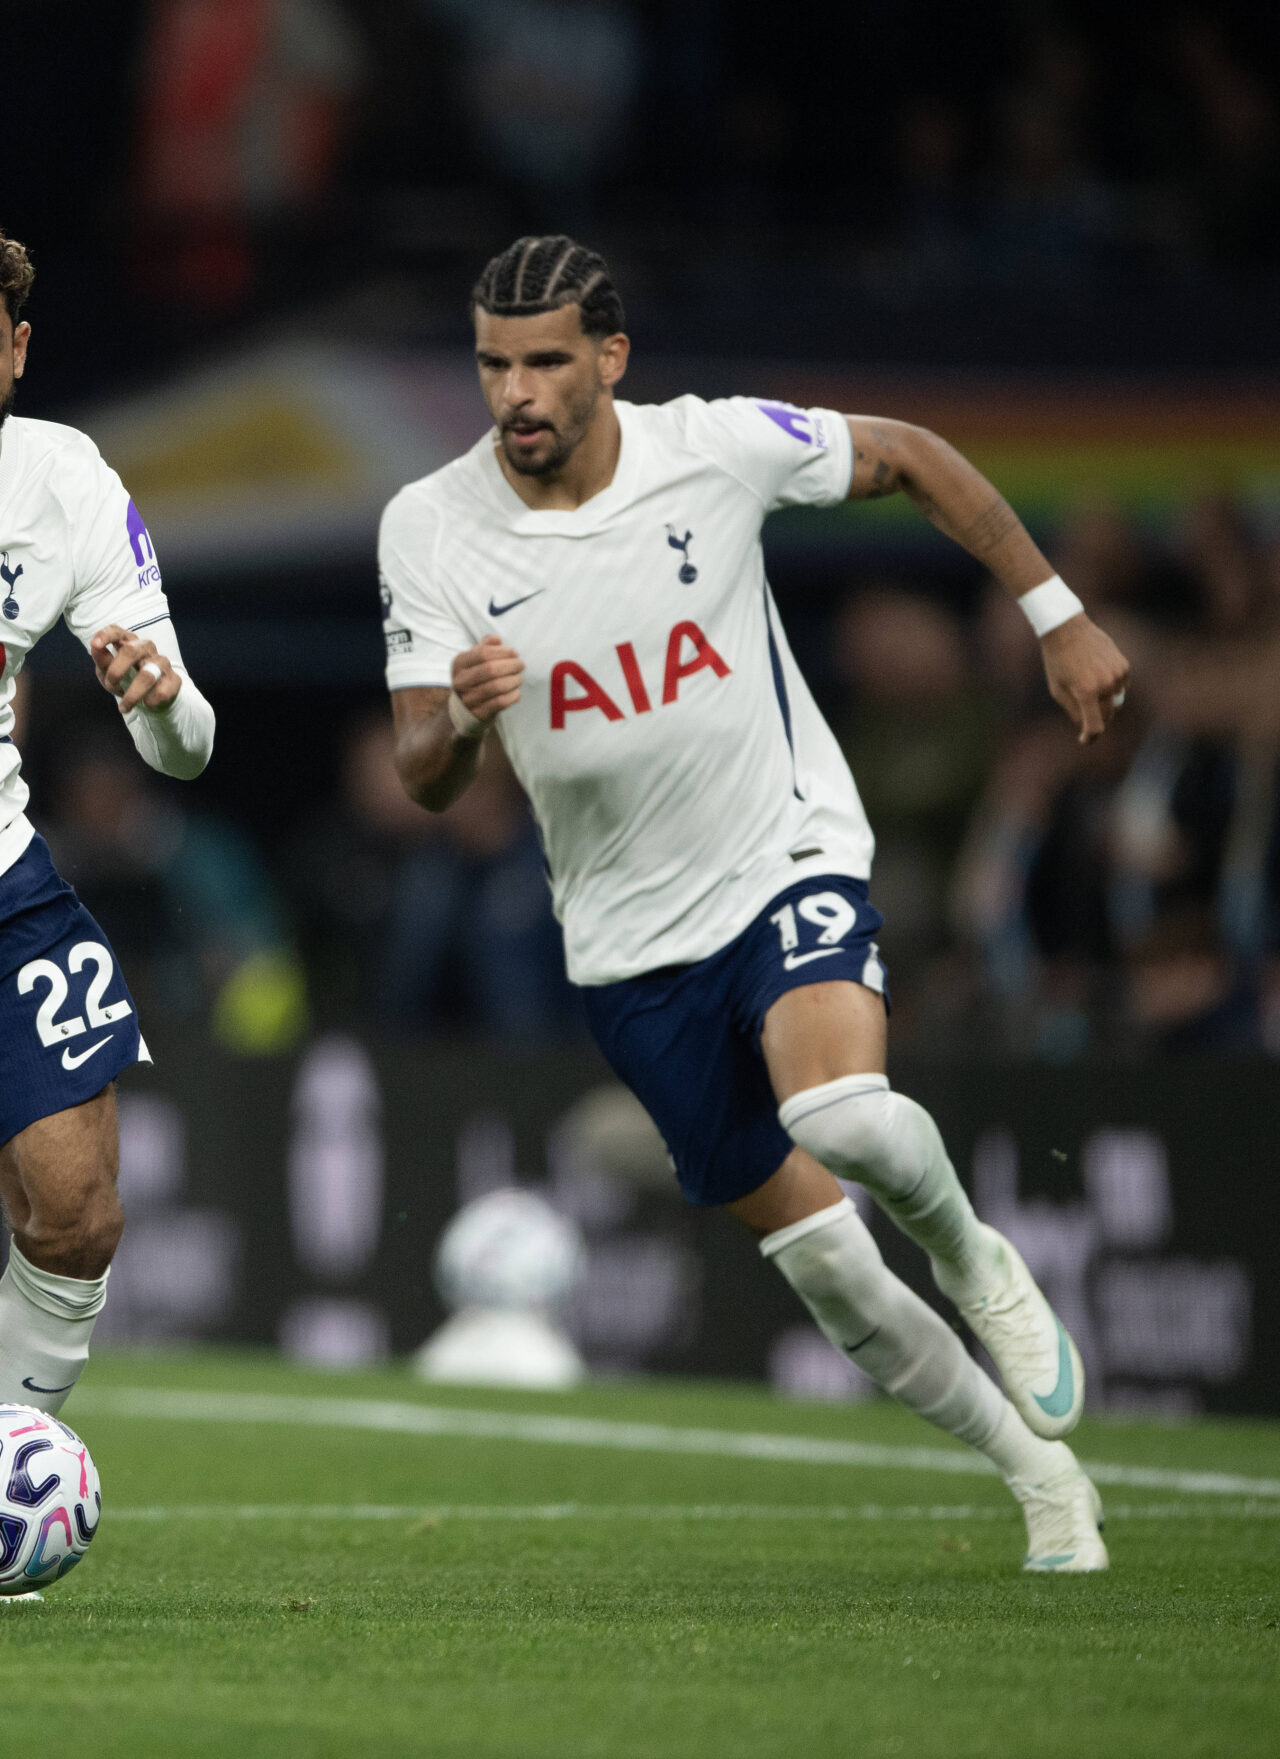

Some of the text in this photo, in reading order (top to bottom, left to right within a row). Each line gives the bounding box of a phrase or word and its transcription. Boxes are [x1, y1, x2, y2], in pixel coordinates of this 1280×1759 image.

[550, 621, 732, 730] AIA
[769, 891, 857, 952] 19
[17, 940, 133, 1048] 22
